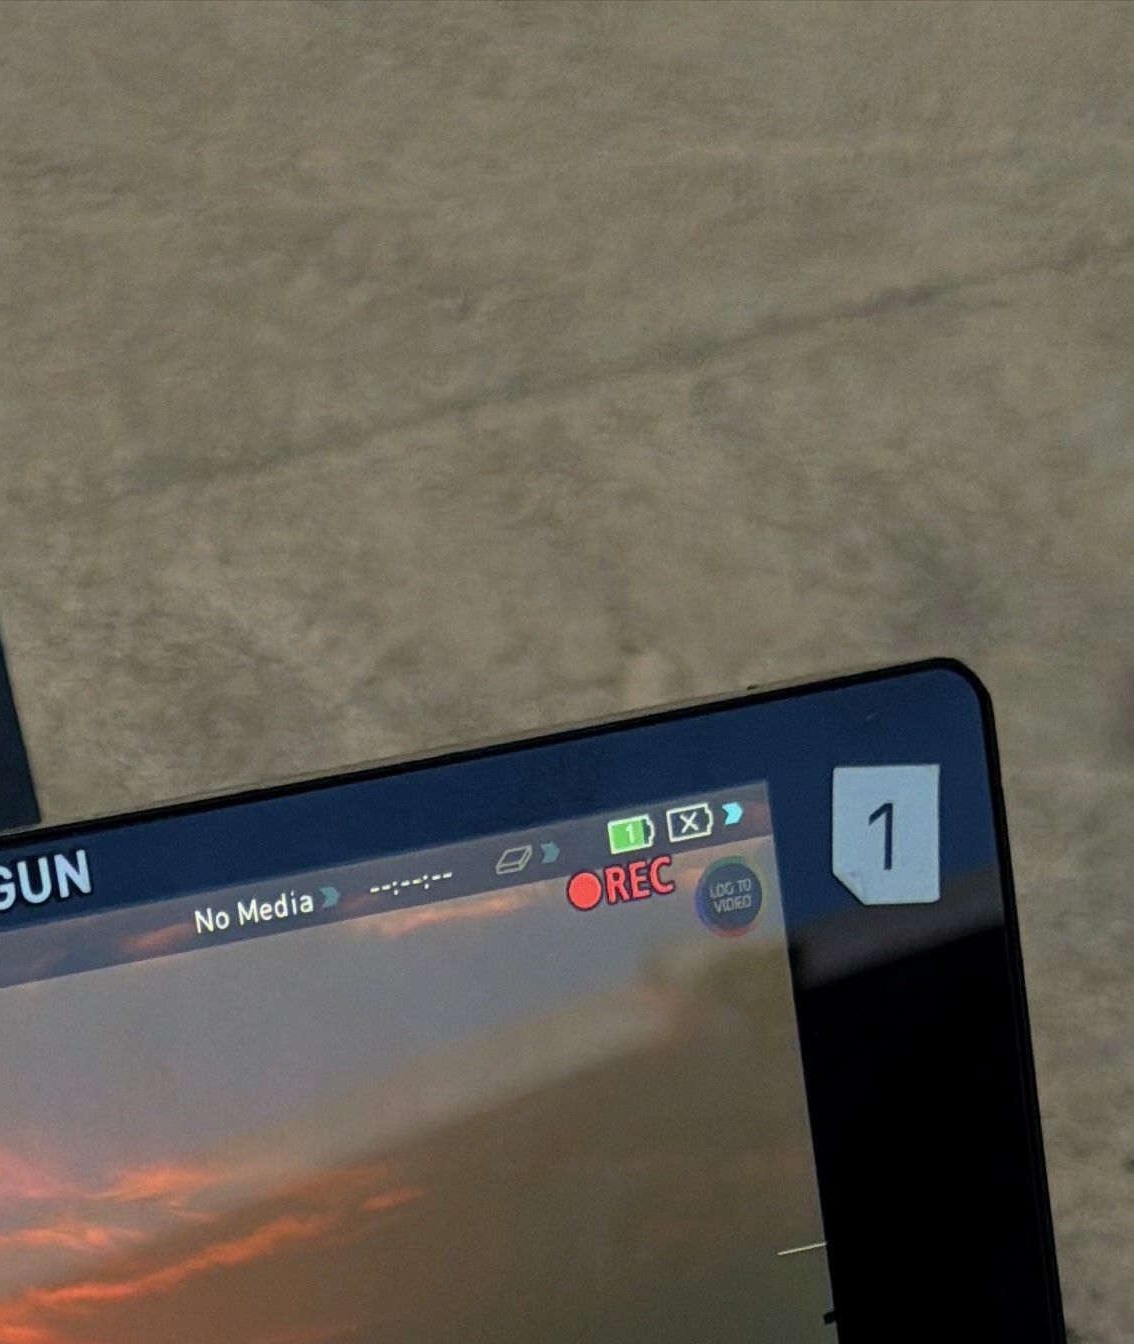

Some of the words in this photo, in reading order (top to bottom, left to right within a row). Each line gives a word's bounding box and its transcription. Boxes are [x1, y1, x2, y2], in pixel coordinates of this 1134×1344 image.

[867, 803, 894, 870] 1
[604, 856, 675, 904] REC
[194, 907, 229, 933] No
[237, 891, 314, 925] Media
[713, 894, 752, 913] VIDEO
